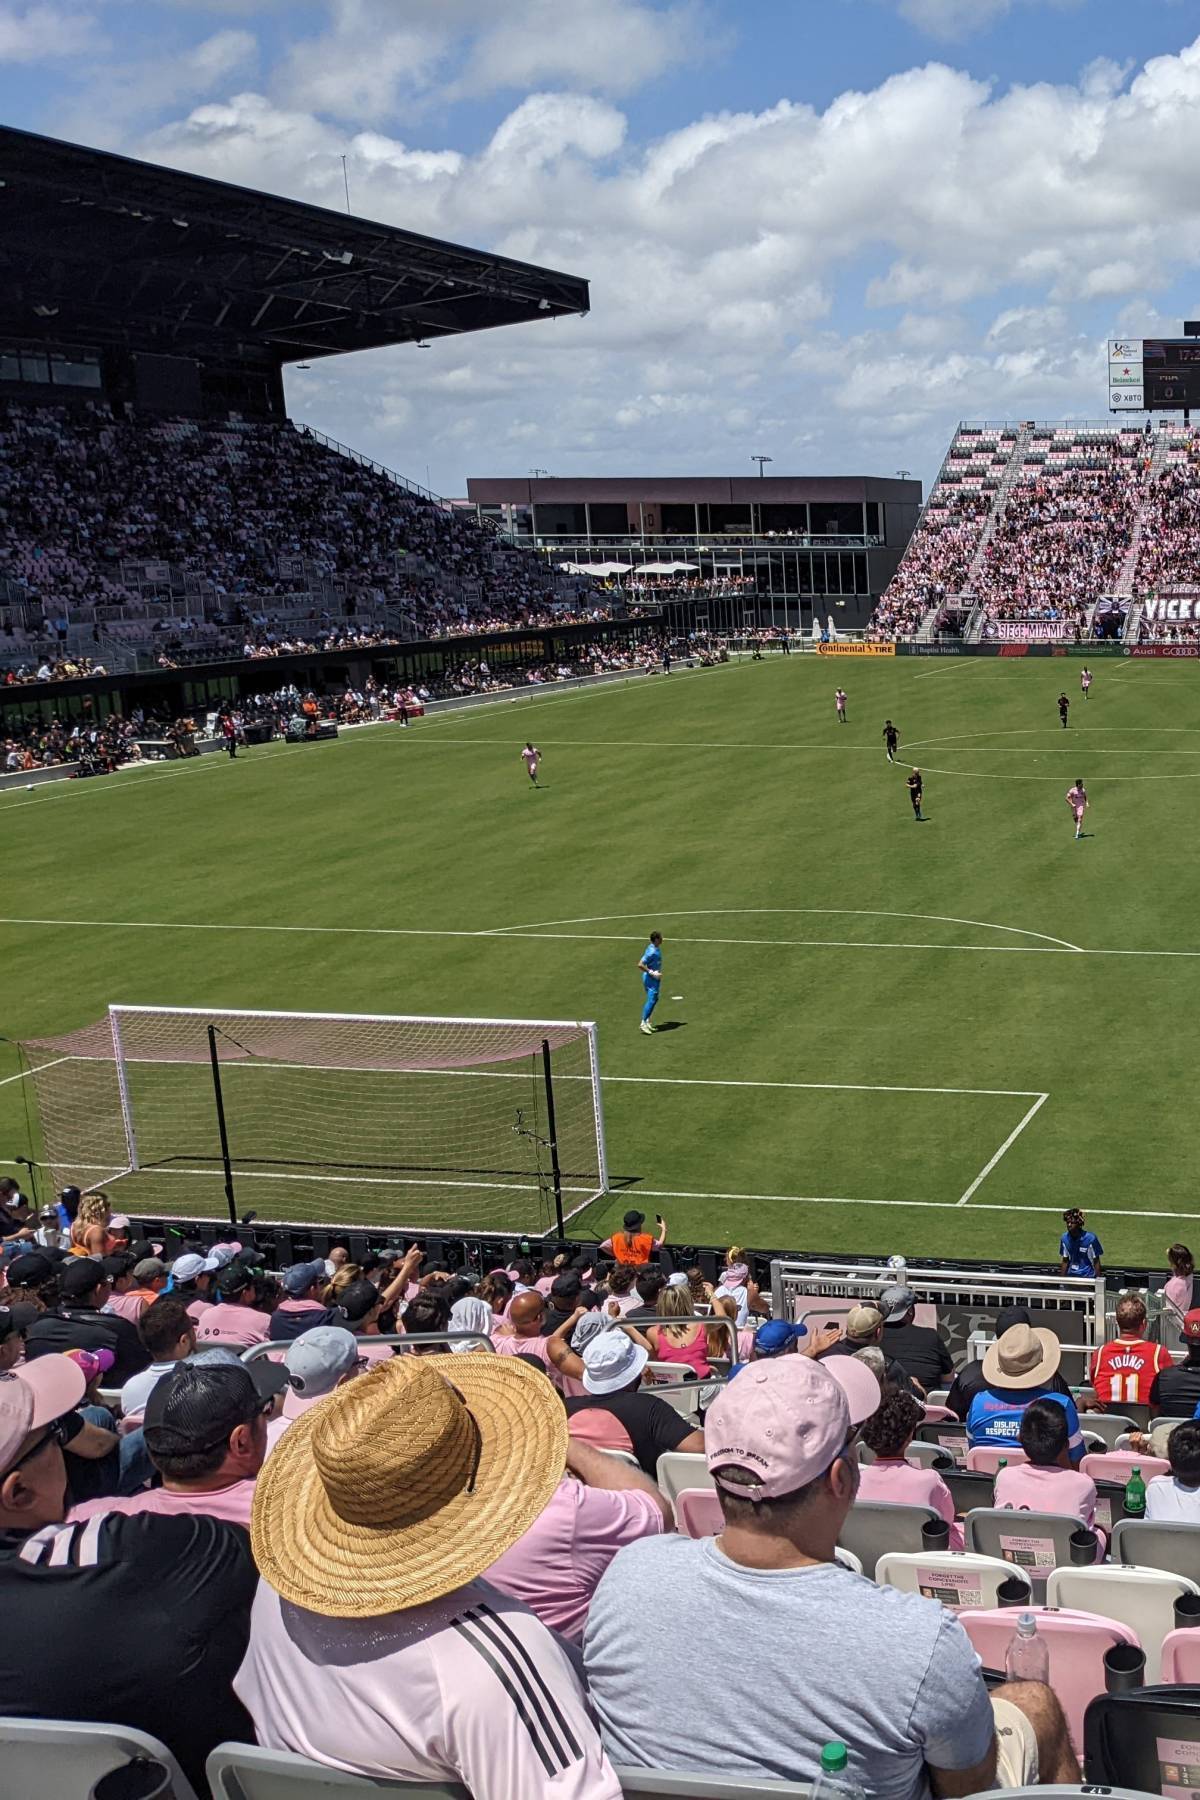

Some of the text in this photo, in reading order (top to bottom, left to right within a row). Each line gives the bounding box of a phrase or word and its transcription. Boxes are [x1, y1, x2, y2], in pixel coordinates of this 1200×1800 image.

[1145, 599, 1192, 620] VICE
[1000, 624, 1063, 639] SIEGE MIAMI
[818, 643, 866, 653] Continental
[1108, 1355, 1146, 1371] YOUNG
[1109, 1373, 1139, 1403] 11
[710, 1447, 734, 1460] FREEDOM
[746, 1451, 769, 1469] DREAM
